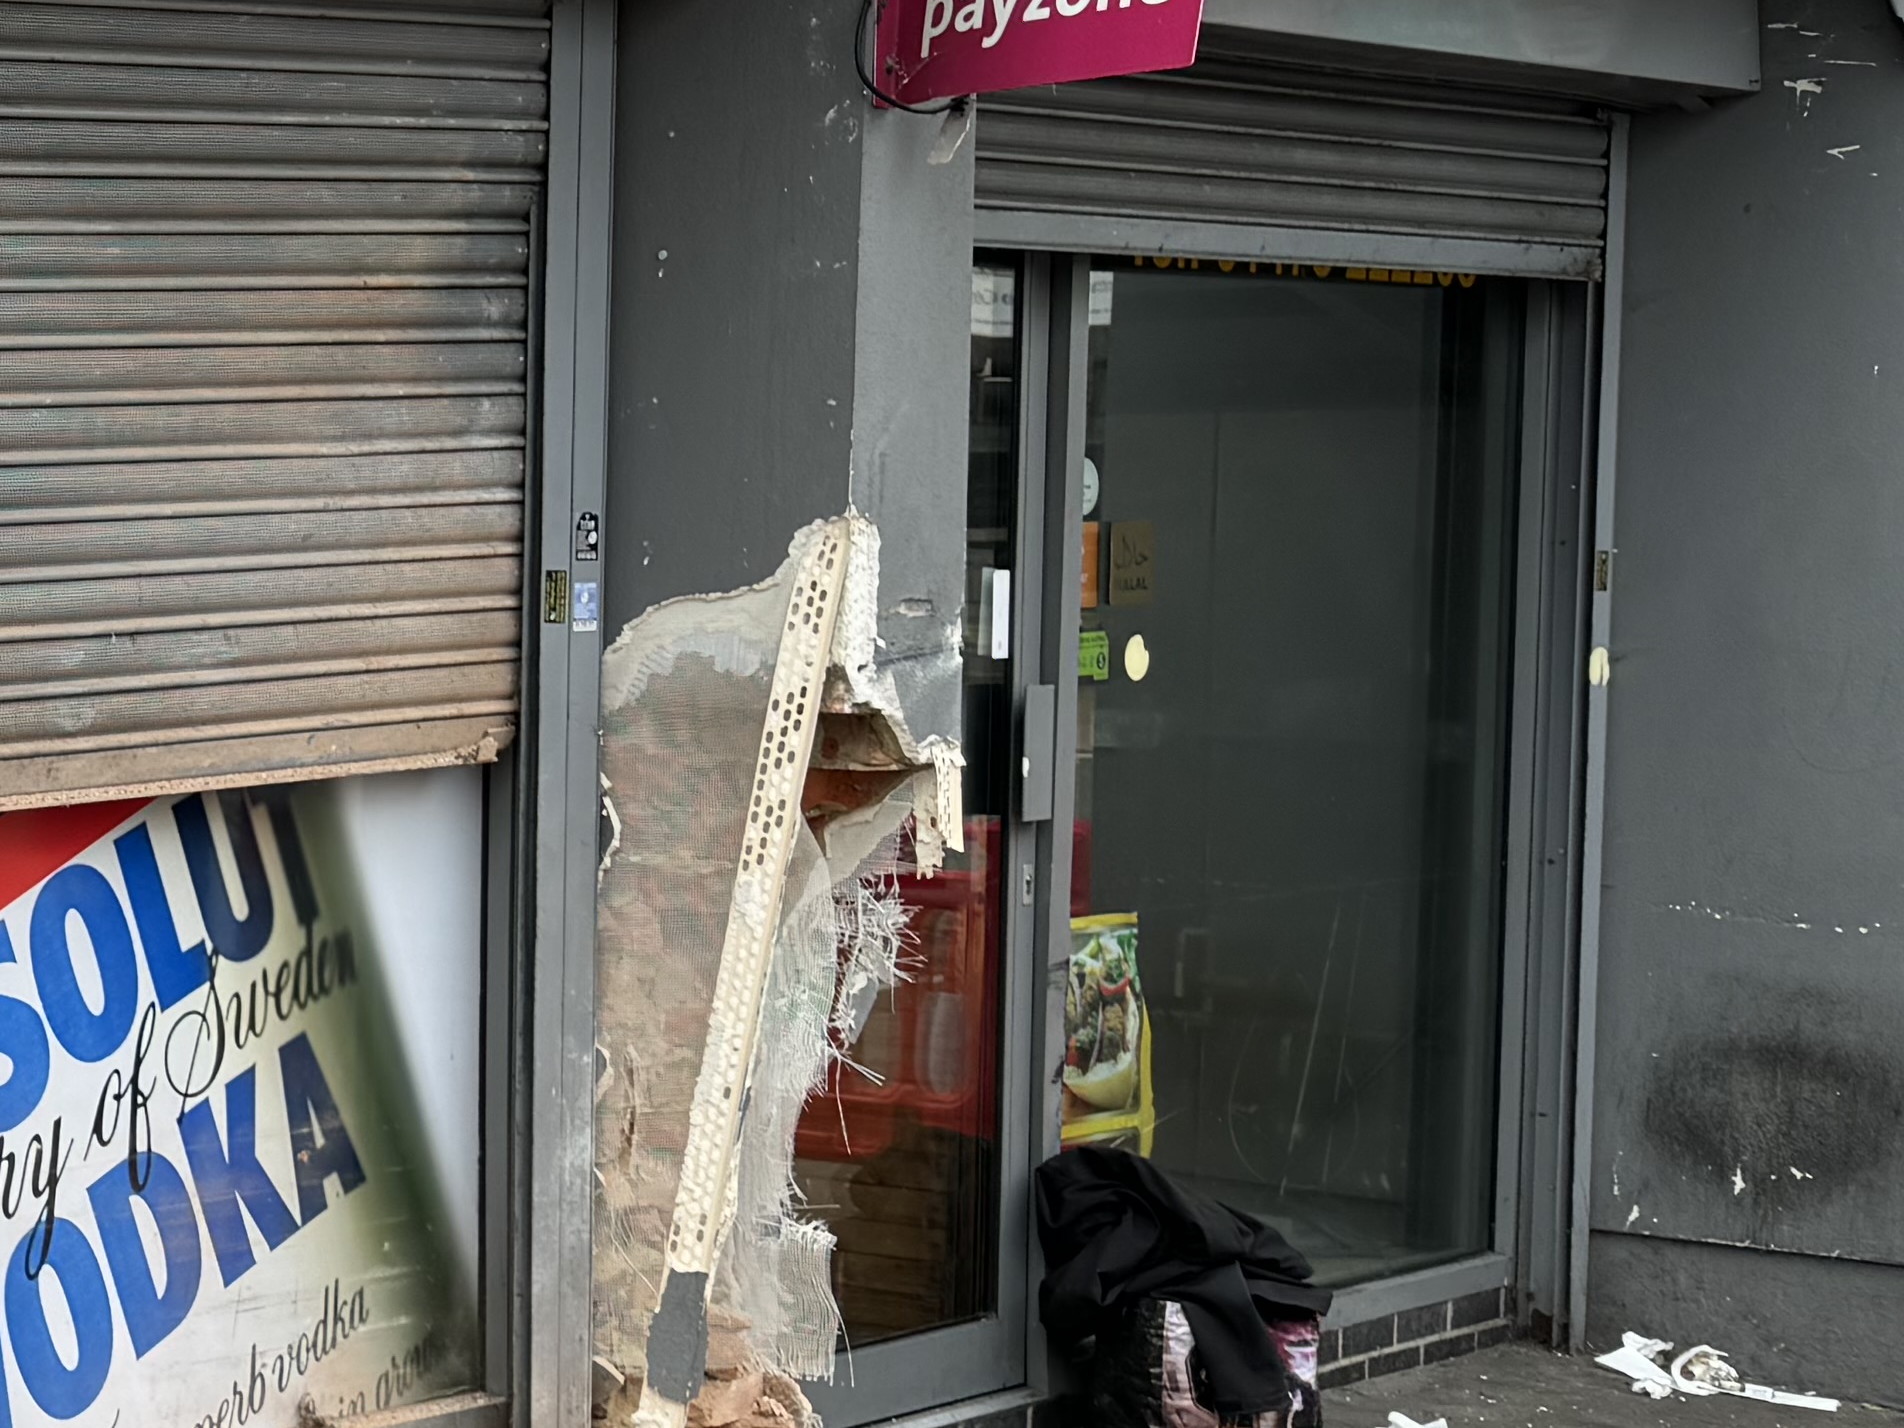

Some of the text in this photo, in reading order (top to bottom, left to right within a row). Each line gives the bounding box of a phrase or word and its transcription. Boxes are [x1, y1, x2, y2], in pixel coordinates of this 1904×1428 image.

[83, 1001, 159, 1195] of
[163, 917, 360, 1104] Sweden
[270, 1277, 370, 1394] vodka
